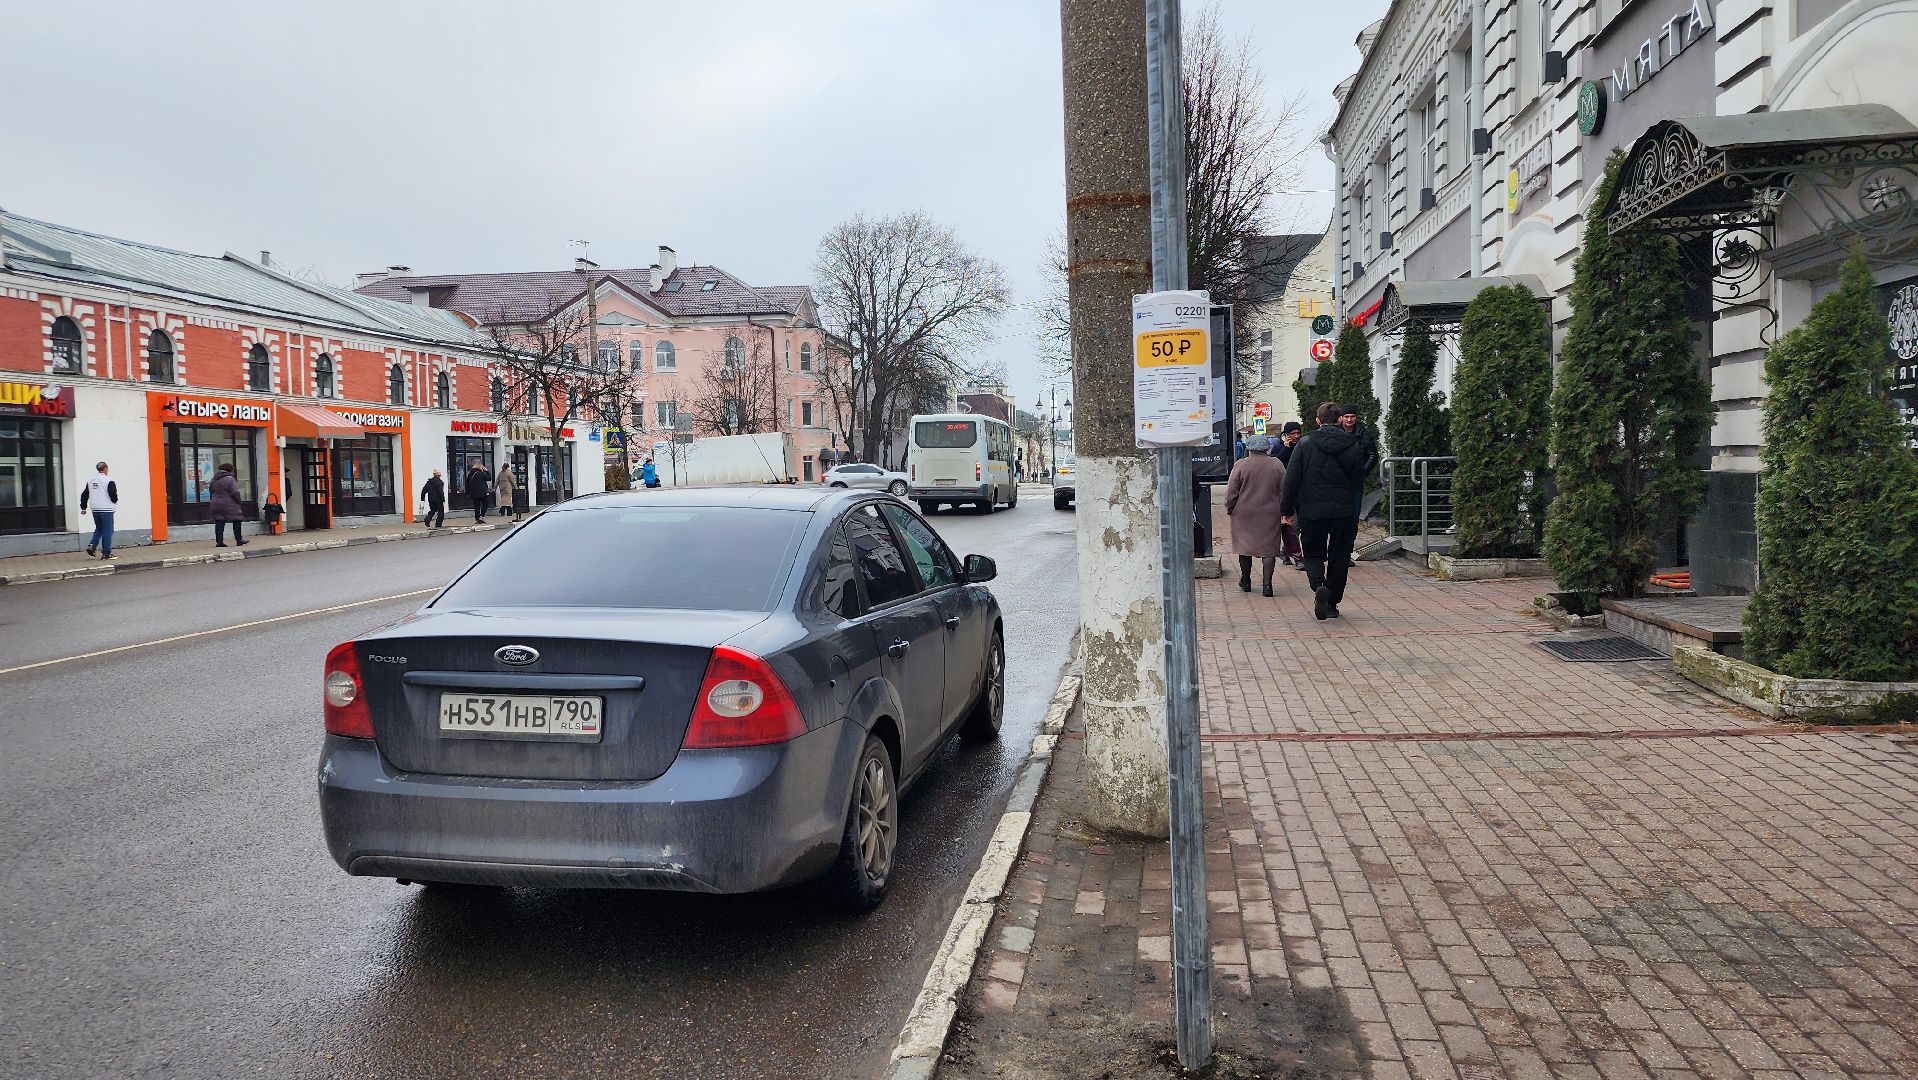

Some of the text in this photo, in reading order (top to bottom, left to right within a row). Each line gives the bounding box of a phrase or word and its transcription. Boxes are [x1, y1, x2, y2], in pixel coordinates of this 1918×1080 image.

[1612, 0, 1713, 103] МЯТА
[1175, 306, 1206, 316] 02201
[1151, 340, 1174, 358] 50
[231, 404, 272, 421] лапы
[368, 654, 408, 664] FOCUS
[503, 649, 529, 661] Ford
[448, 698, 593, 728] Н531НВ 790
